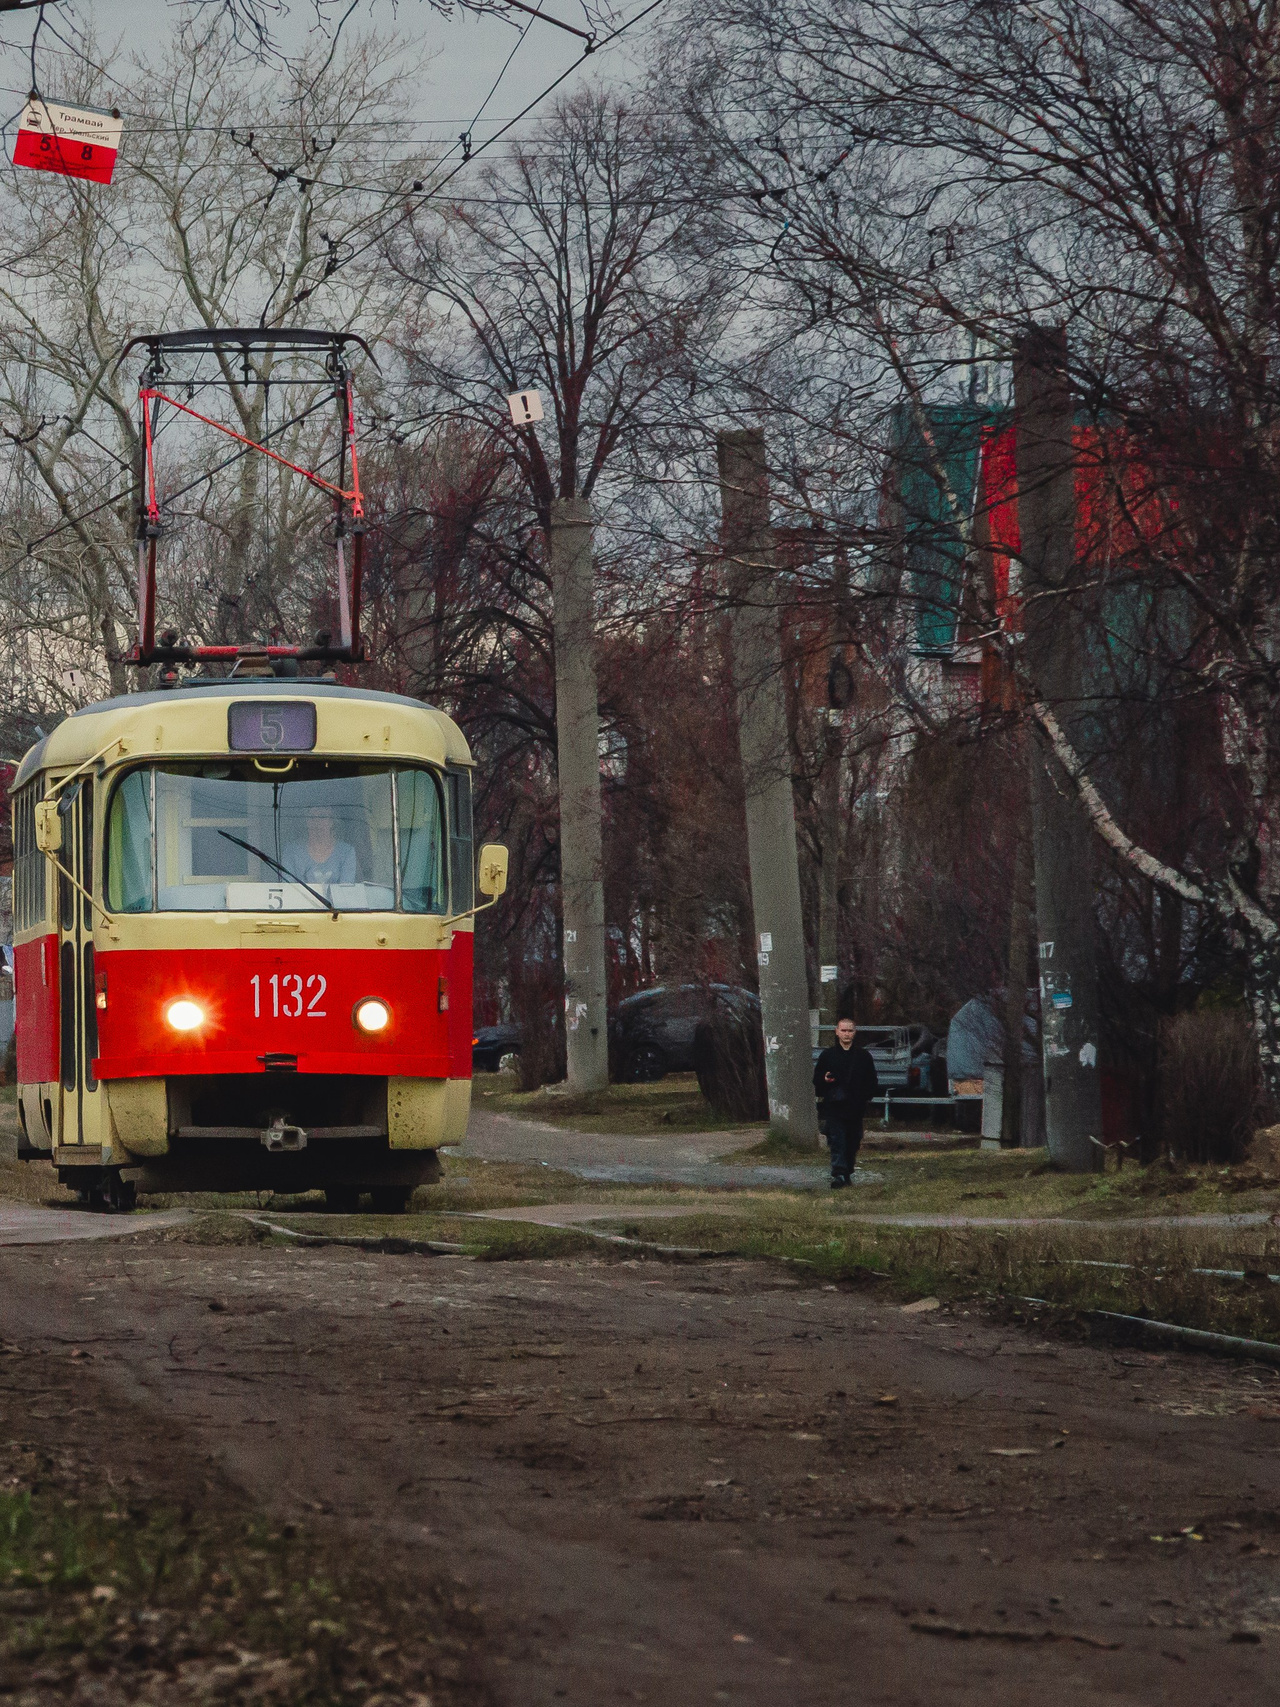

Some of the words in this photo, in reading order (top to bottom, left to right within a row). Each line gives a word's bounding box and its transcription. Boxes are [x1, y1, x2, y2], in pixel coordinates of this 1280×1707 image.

[59, 111, 104, 128] Трамвай
[39, 135, 52, 151] 5
[81, 145, 93, 160] 8
[260, 707, 284, 747] 5
[268, 888, 284, 910] 5
[250, 973, 327, 1018] 1132
